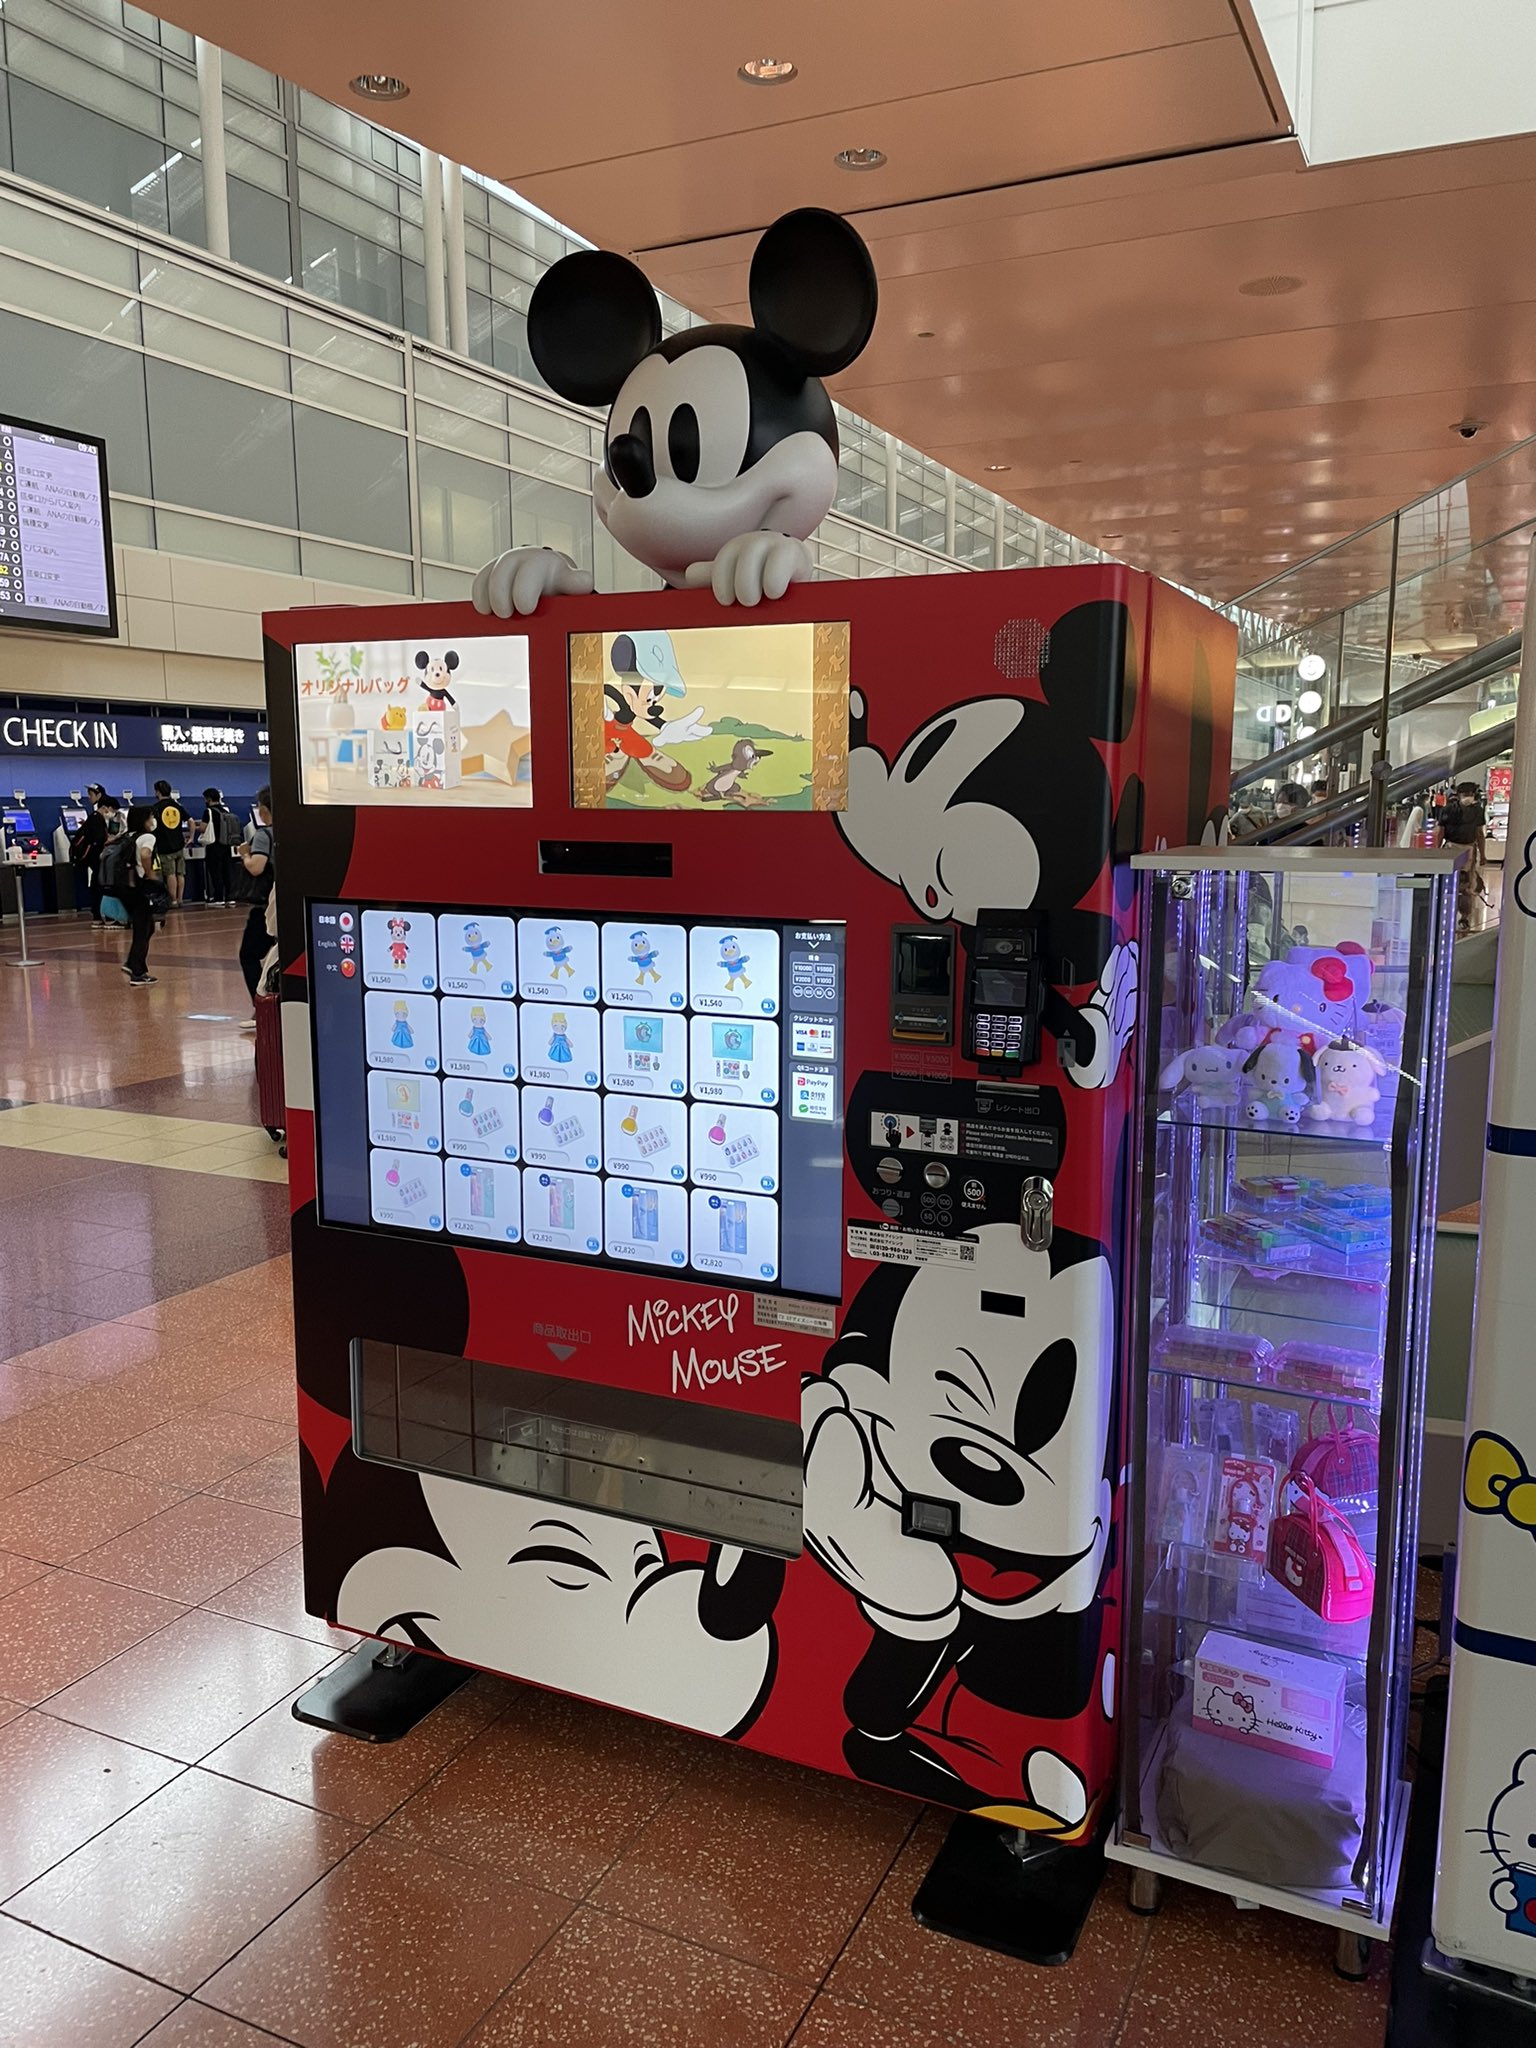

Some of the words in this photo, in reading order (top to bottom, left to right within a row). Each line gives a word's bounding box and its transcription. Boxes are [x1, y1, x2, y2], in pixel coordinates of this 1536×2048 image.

[301, 676, 409, 695] オリジナルバッグ
[3, 717, 90, 748] CHECK
[94, 722, 118, 749] IN
[162, 741, 198, 755] Ticketing
[199, 743, 206, 753] &
[206, 743, 229, 753] Check
[318, 941, 337, 949] English
[372, 976, 391, 984] ¥1,540
[448, 982, 468, 990] ¥1,540
[528, 987, 549, 996] ¥1,540
[611, 992, 633, 1001] ¥1,540
[699, 999, 722, 1008] ¥1,540
[793, 1015, 833, 1024] クレジットカード
[529, 1070, 550, 1079] ¥1,980
[612, 1078, 635, 1087] ¥1,980
[807, 1078, 828, 1087] PayPay
[699, 1086, 723, 1095] ¥1,980
[996, 1104, 1040, 1115] レシート出口
[452, 1143, 467, 1151] ¥990
[530, 1152, 546, 1161] ¥990
[613, 1163, 630, 1171] ¥990
[699, 1173, 717, 1182] ¥990
[872, 1187, 911, 1198] おつり・返却
[967, 1189, 981, 1197] 500
[922, 1196, 936, 1204] 500
[939, 1198, 951, 1206] 100
[961, 1201, 987, 1210] 使えません。
[613, 1245, 636, 1255] ¥2,820
[699, 1258, 723, 1268] ¥2,820
[533, 1322, 592, 1344] 商品取出口
[1266, 1718, 1293, 1732] Hello
[1295, 1725, 1318, 1742] Kitty
